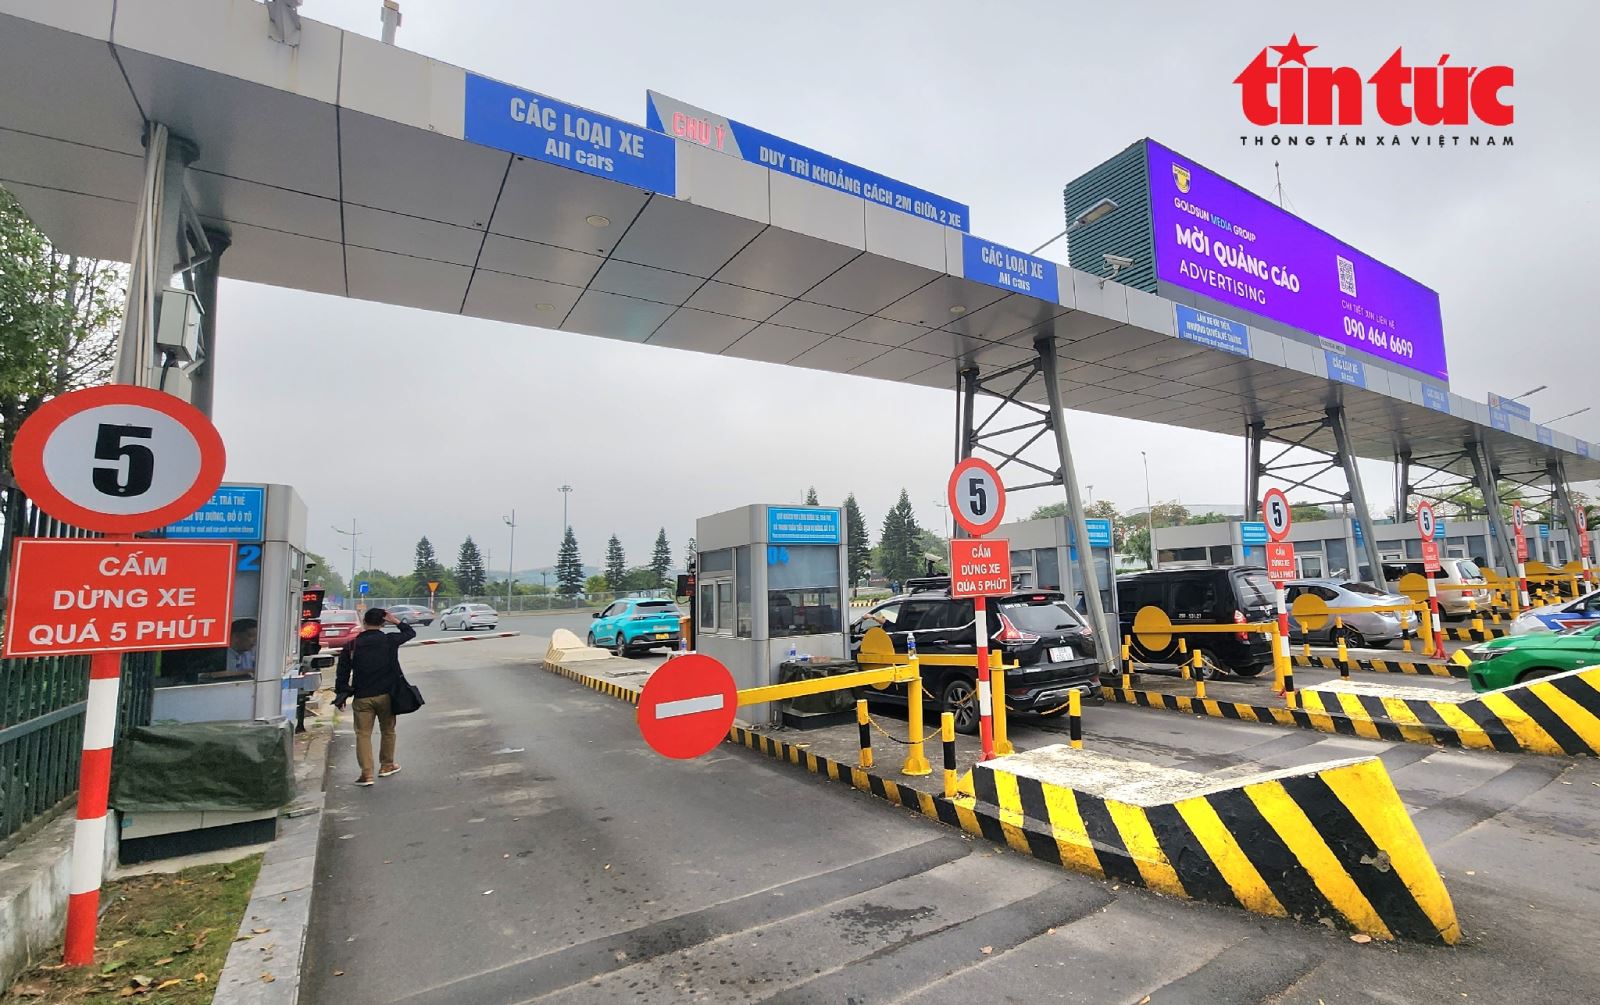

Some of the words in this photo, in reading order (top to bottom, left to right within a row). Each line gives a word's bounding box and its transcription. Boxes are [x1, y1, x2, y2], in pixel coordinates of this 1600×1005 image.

[510, 97, 557, 131] CÁC
[564, 113, 611, 149] LOẠI
[618, 130, 645, 158] XE
[672, 111, 710, 145] CHÚ
[714, 124, 725, 151] Ý
[545, 138, 570, 161] All
[575, 148, 614, 172] cars
[760, 146, 785, 168] DUY
[789, 157, 809, 177] TRÌ
[812, 165, 861, 194] KHOẢNG
[863, 183, 893, 205] CÁCH
[895, 195, 912, 211] 2M
[914, 201, 938, 220] GIỮA
[940, 210, 946, 223] 2
[948, 212, 961, 228] XE
[1174, 197, 1210, 221] GOLDSUN
[1210, 214, 1232, 232] MEDIA
[1233, 225, 1256, 242] GROUP
[981, 246, 1003, 268] CÁC
[1006, 254, 1028, 276] LOẠI
[1031, 261, 1043, 280] XE
[1176, 223, 1210, 256] MỜI
[1213, 241, 1268, 280] QUẢNG
[1270, 266, 1300, 293] CÁO
[999, 272, 1010, 286] All
[1012, 277, 1030, 291] cars
[1180, 259, 1266, 304] ADVERTISING
[1343, 316, 1365, 340] 090
[1368, 326, 1387, 349] 464
[1390, 335, 1413, 359] 6699
[92, 423, 154, 497] 5
[969, 478, 987, 516] 5
[1272, 502, 1283, 527] 5
[1424, 512, 1431, 531] 5
[99, 551, 167, 576] CẤM
[971, 543, 991, 558] CẤM
[961, 561, 987, 576] DỪNG
[988, 563, 1001, 574] XE
[978, 580, 983, 591] 5
[984, 577, 1007, 591] PHÚT
[53, 585, 148, 610] DỪNG
[157, 587, 195, 607] XE
[28, 618, 101, 645] QUÁ
[110, 622, 127, 641] 5
[136, 615, 216, 640] PHÚT
